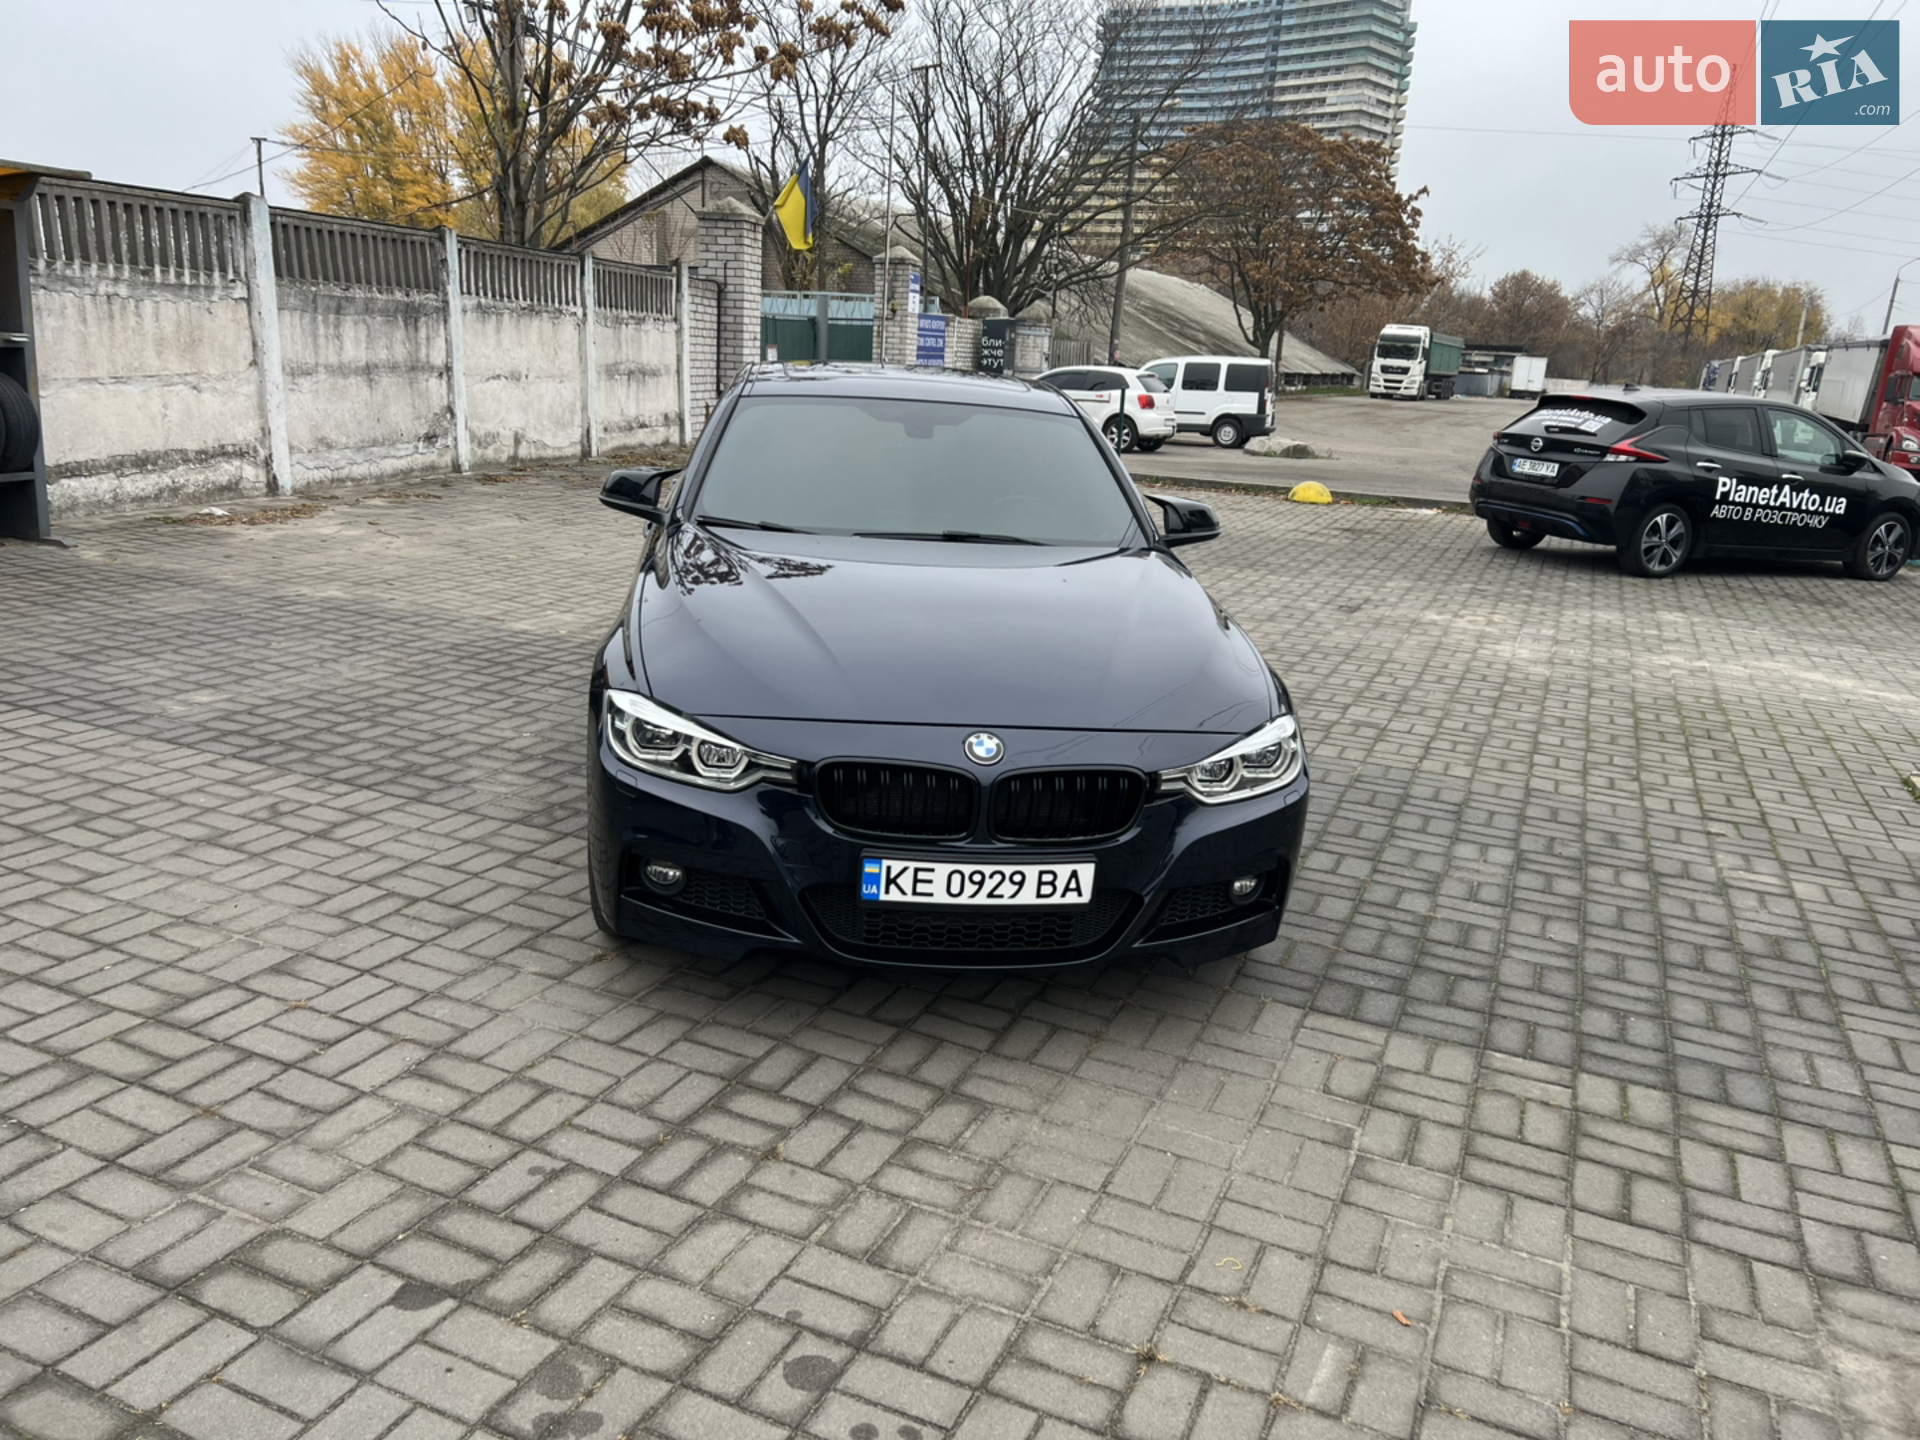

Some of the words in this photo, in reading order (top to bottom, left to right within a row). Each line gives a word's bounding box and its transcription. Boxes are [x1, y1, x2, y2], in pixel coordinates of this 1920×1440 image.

[1715, 477, 1848, 514] PlanetAvto.ua
[1710, 504, 1742, 520] АВТО
[1743, 507, 1754, 521] В
[1754, 509, 1830, 528] РОЗСТРОЧКУ
[862, 884, 878, 895] UA
[884, 865, 935, 897] KE
[946, 869, 1027, 899] 0929
[1036, 869, 1083, 899] BA
